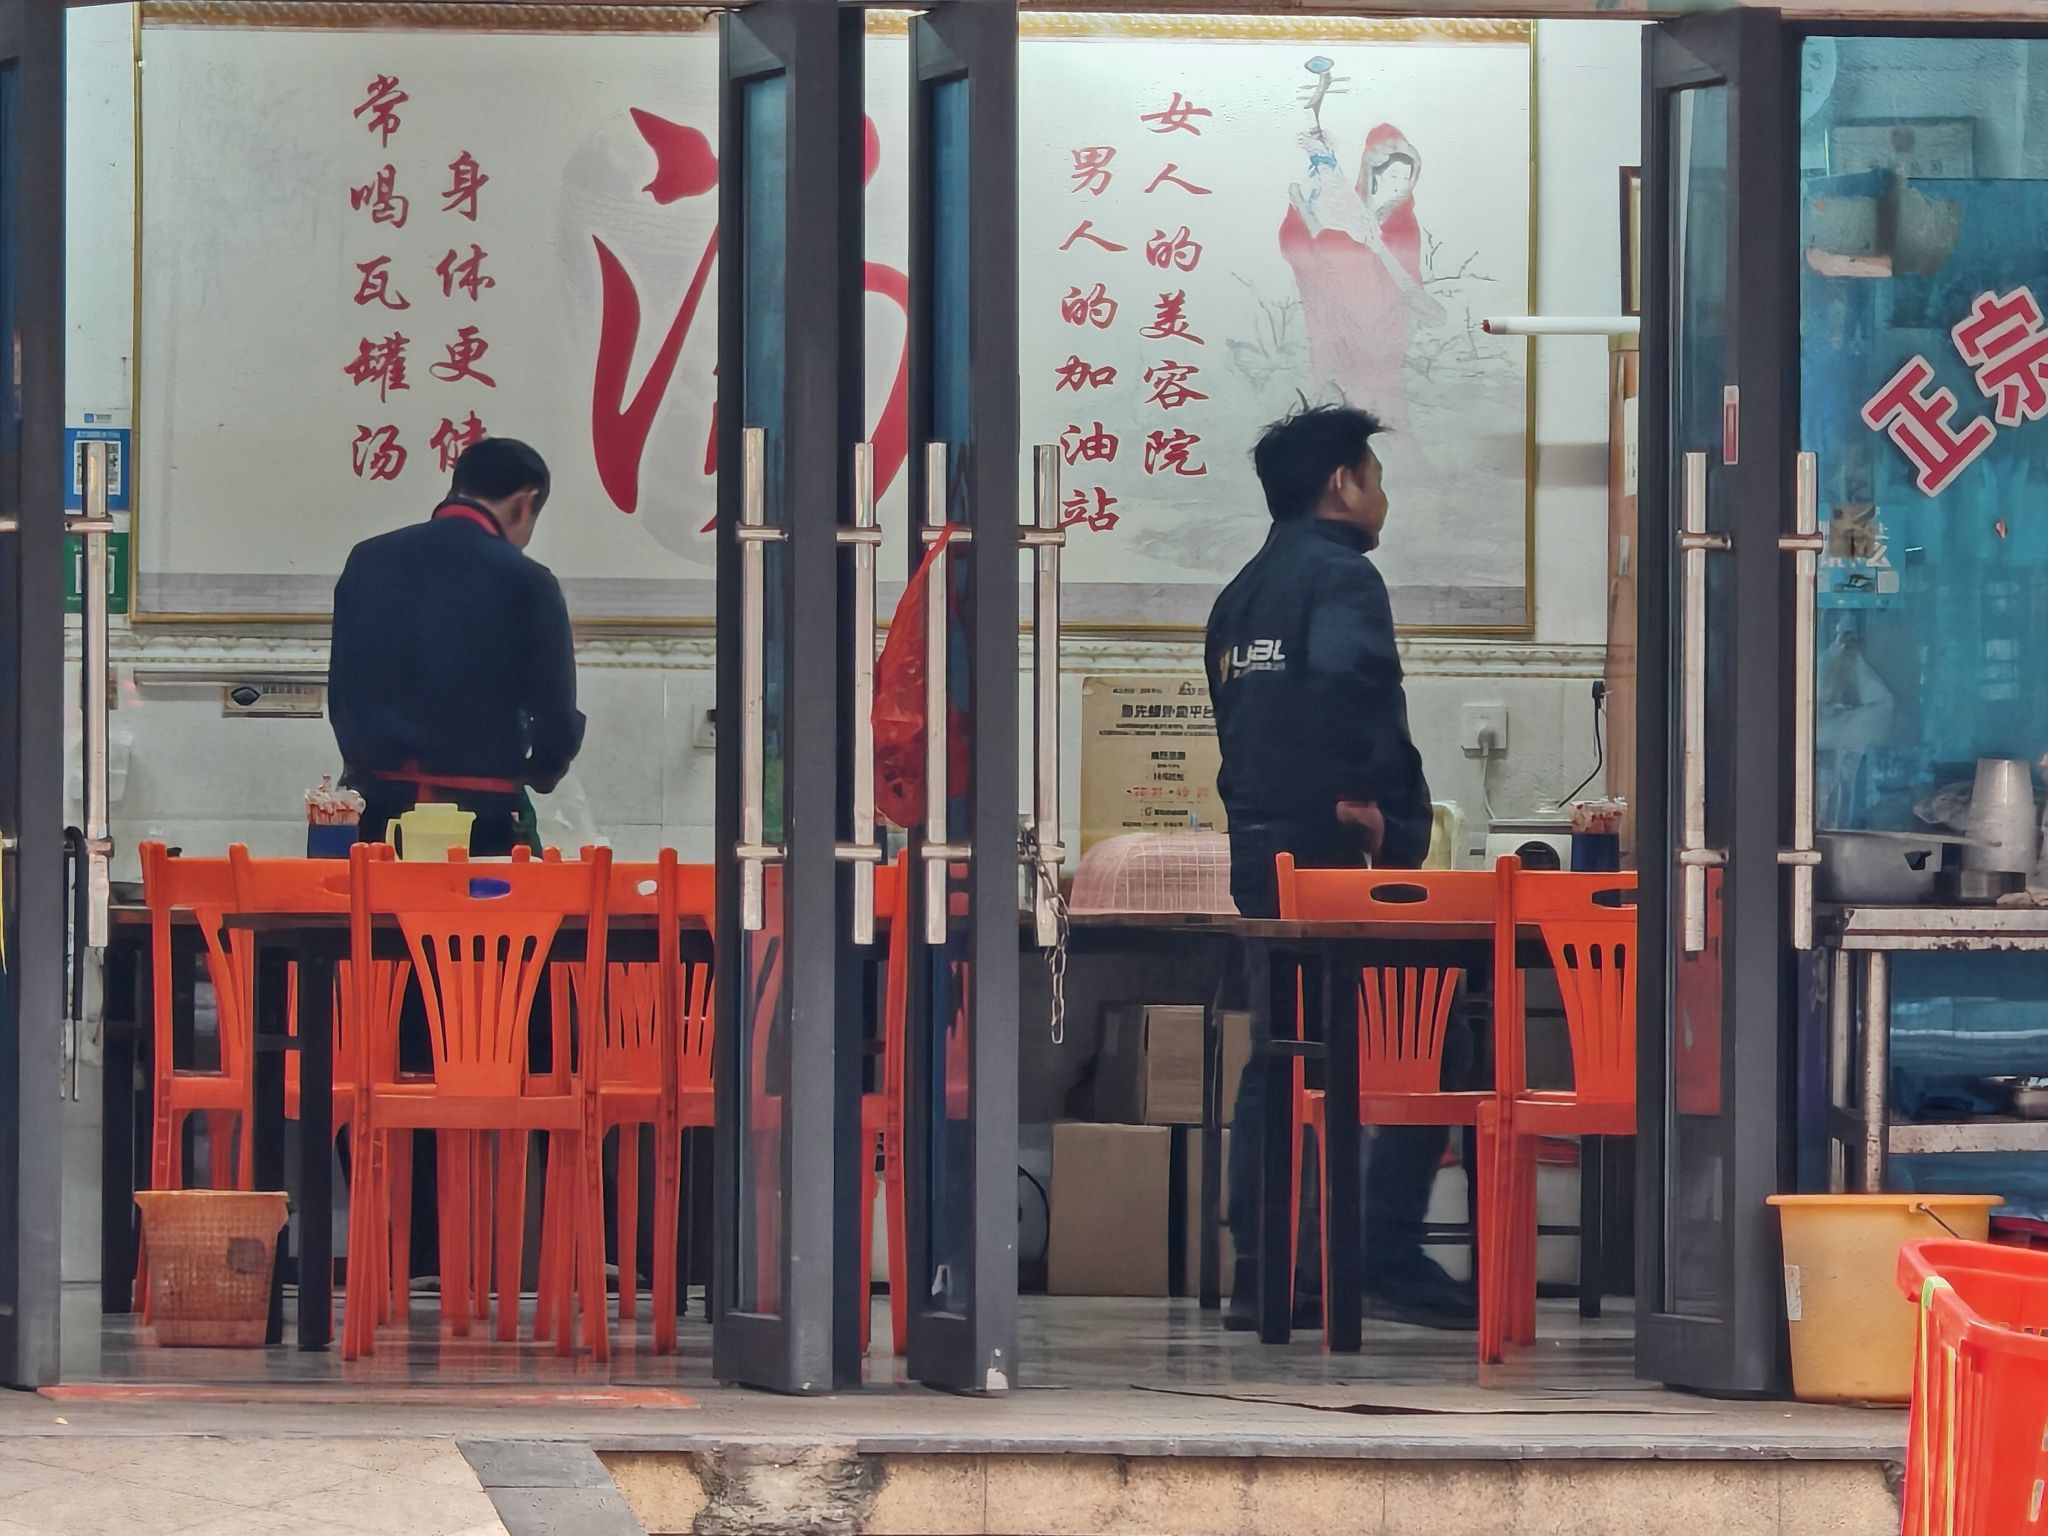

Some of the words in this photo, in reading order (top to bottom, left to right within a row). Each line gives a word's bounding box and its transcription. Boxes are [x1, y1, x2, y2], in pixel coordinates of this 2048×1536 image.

[343, 73, 411, 482] 常喝瓦罐汤
[1055, 145, 1128, 533] 男人的加油站
[1139, 92, 1213, 477] 女人的美容院
[1863, 286, 2048, 496] 正宗
